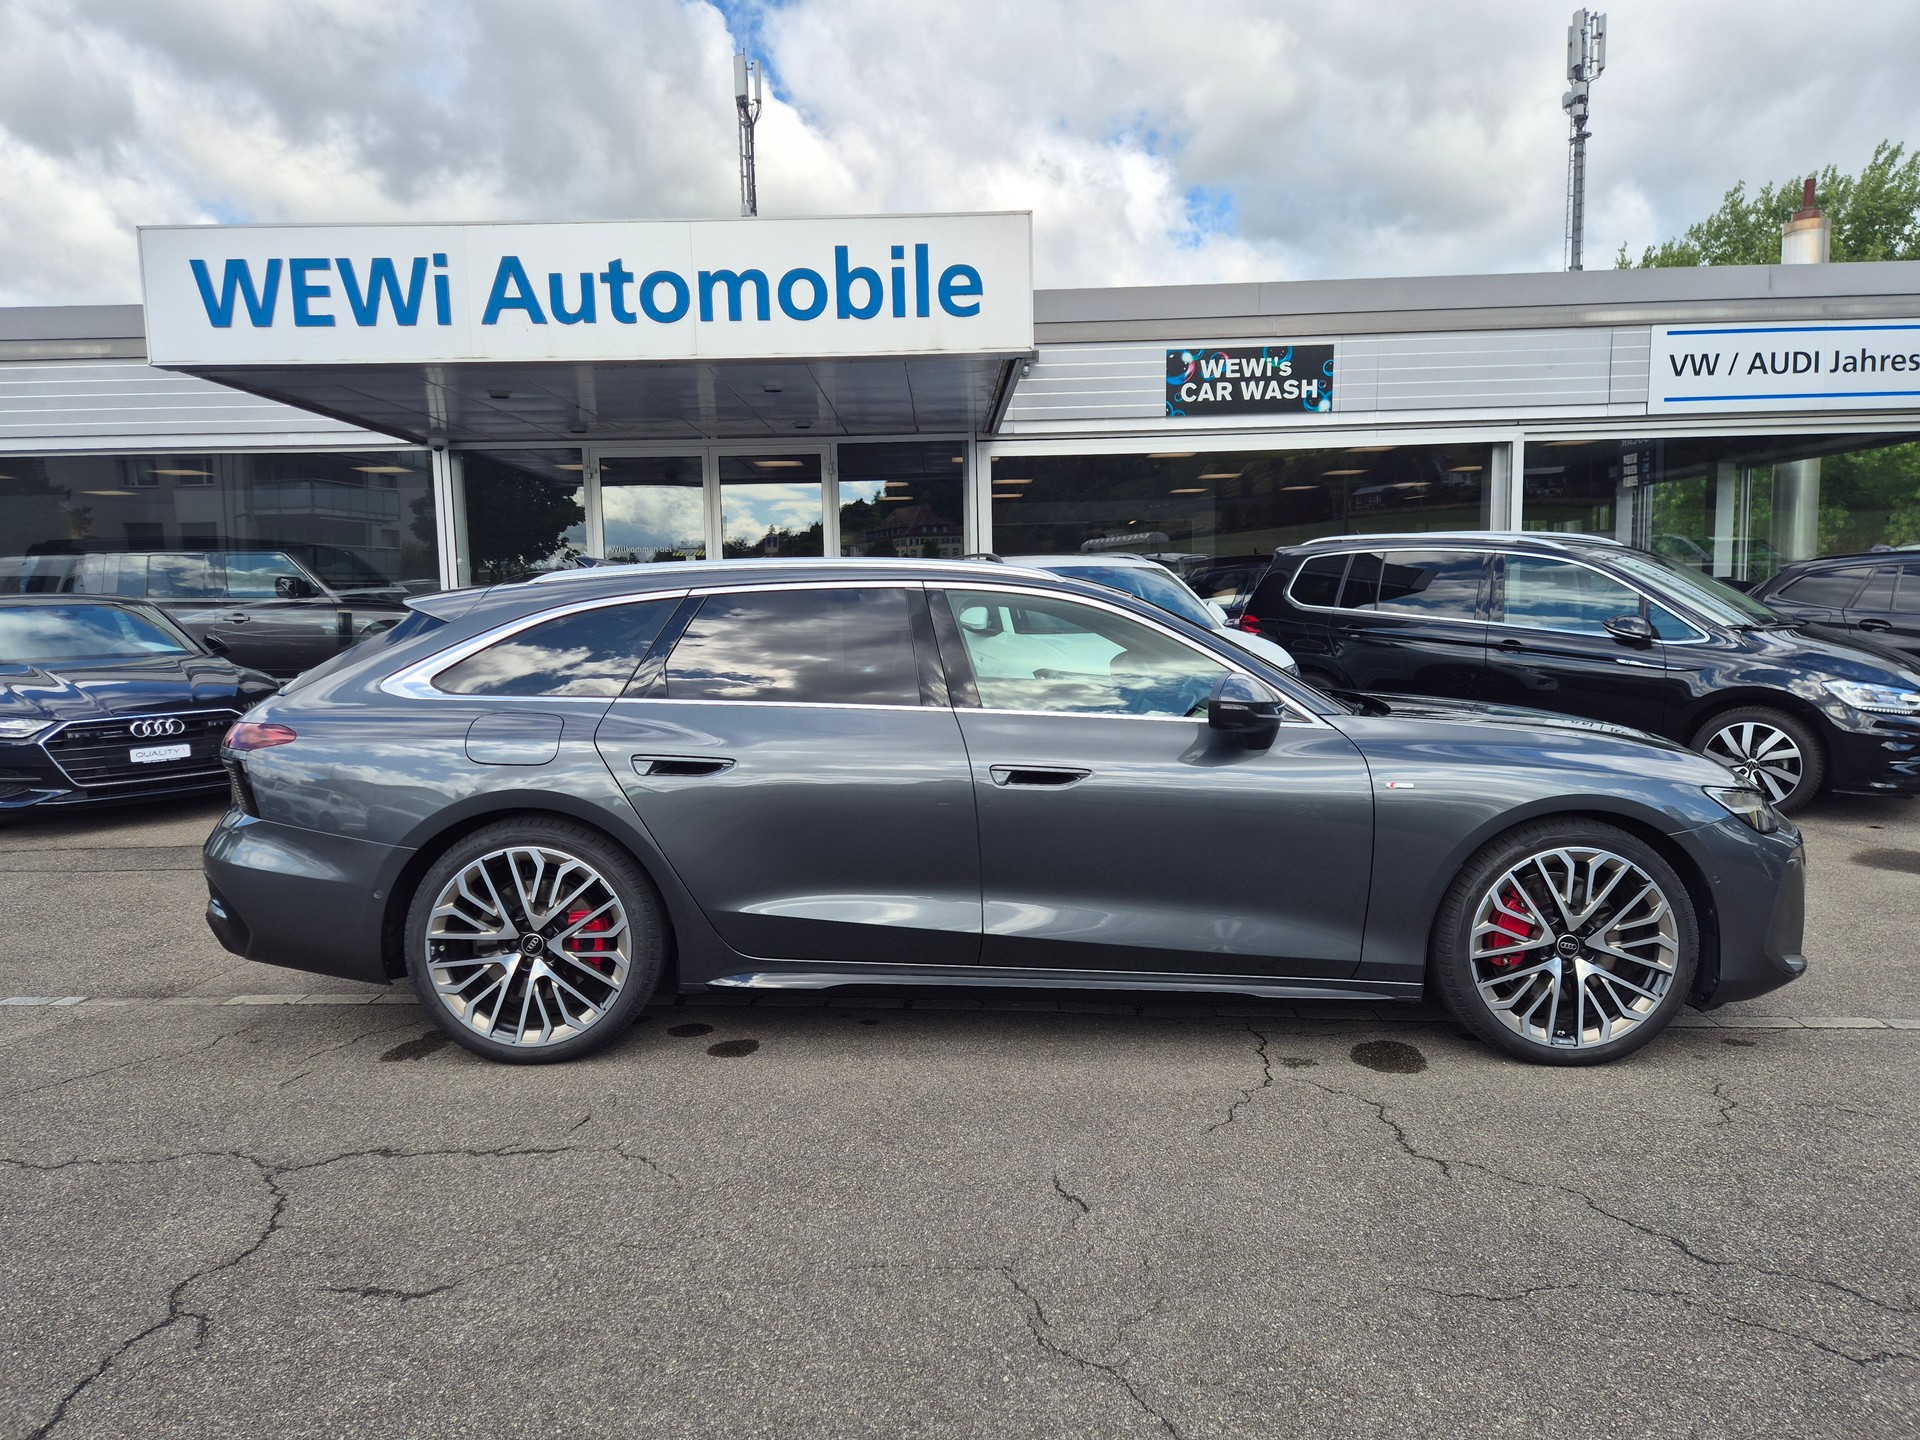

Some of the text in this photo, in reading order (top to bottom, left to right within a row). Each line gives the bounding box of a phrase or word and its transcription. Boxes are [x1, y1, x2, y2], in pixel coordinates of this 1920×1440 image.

[189, 243, 984, 328] WEWi Automobile
[1200, 356, 1292, 379] WEWi's
[1669, 348, 1920, 377] VW / AUDI Jahres
[1180, 379, 1319, 402] CAR WASH
[609, 545, 659, 554] Willkommen
[135, 748, 180, 758] QUALITY
